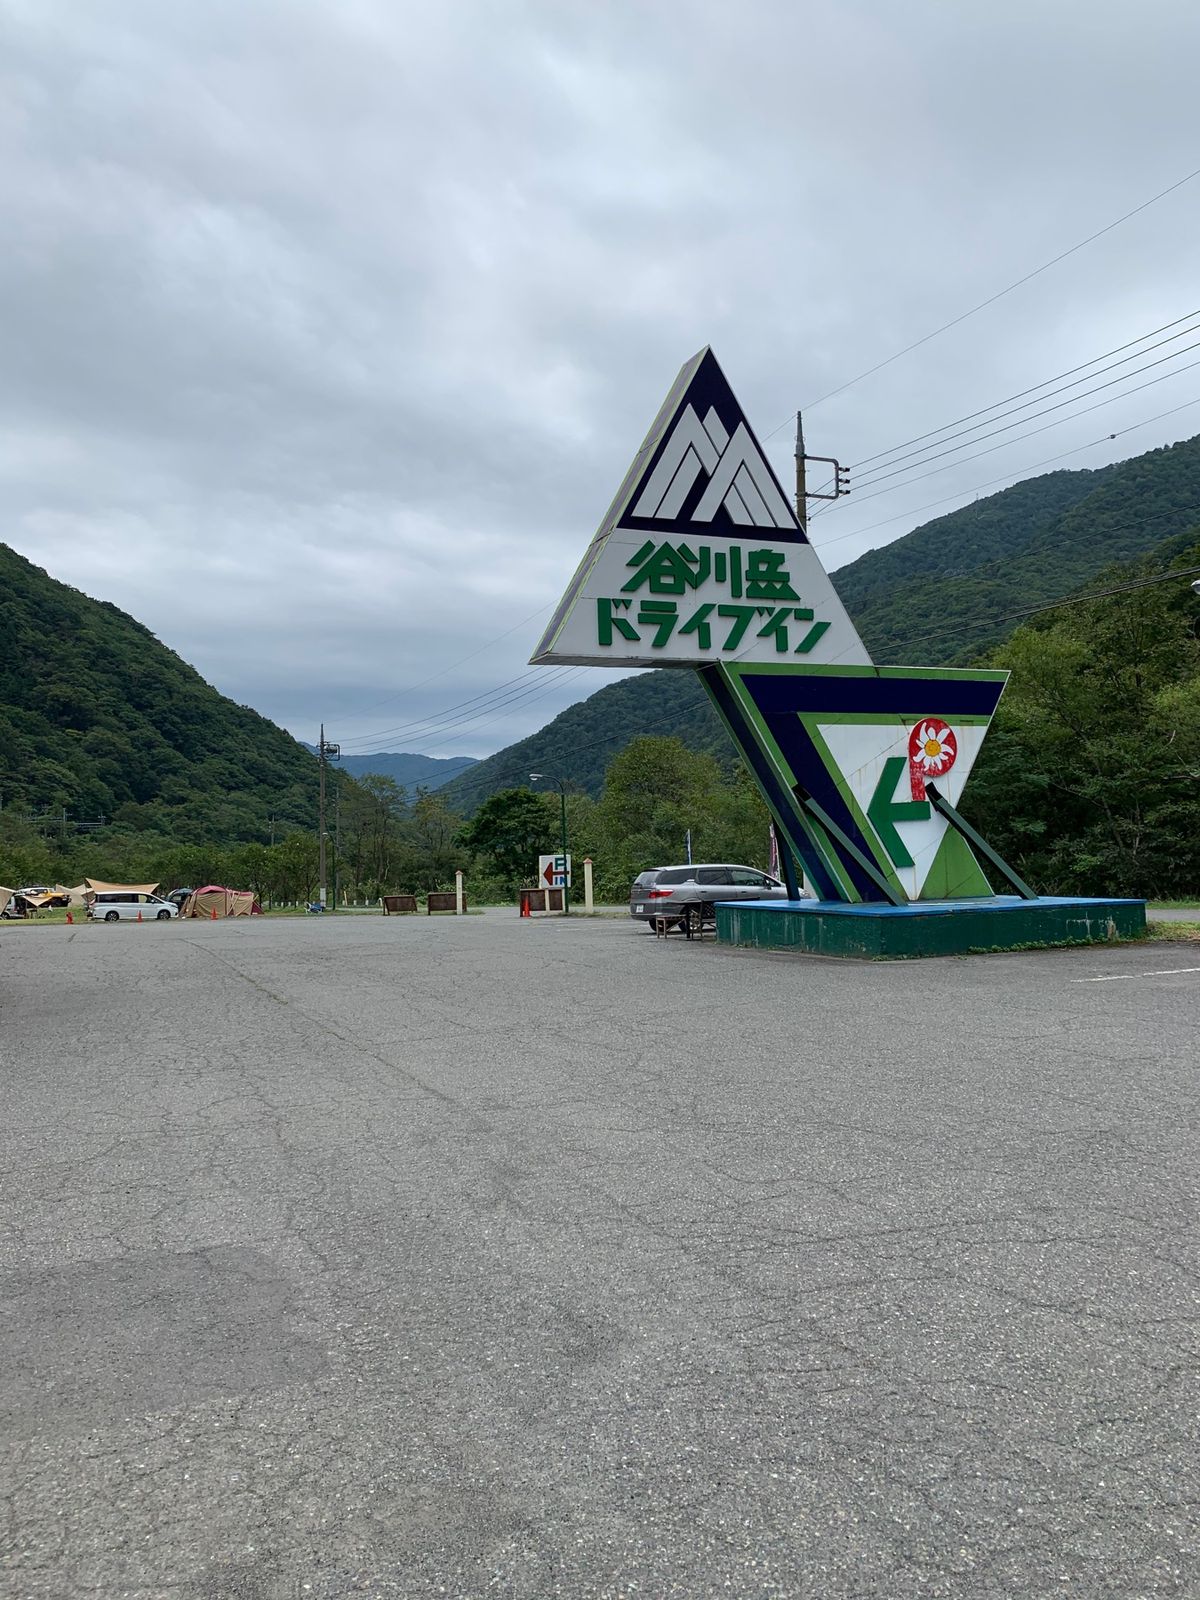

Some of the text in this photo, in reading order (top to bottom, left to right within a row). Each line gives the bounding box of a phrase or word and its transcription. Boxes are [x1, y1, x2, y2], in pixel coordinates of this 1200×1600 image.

[620, 540, 801, 601] 谷川岳
[597, 597, 832, 655] ドライブイン
